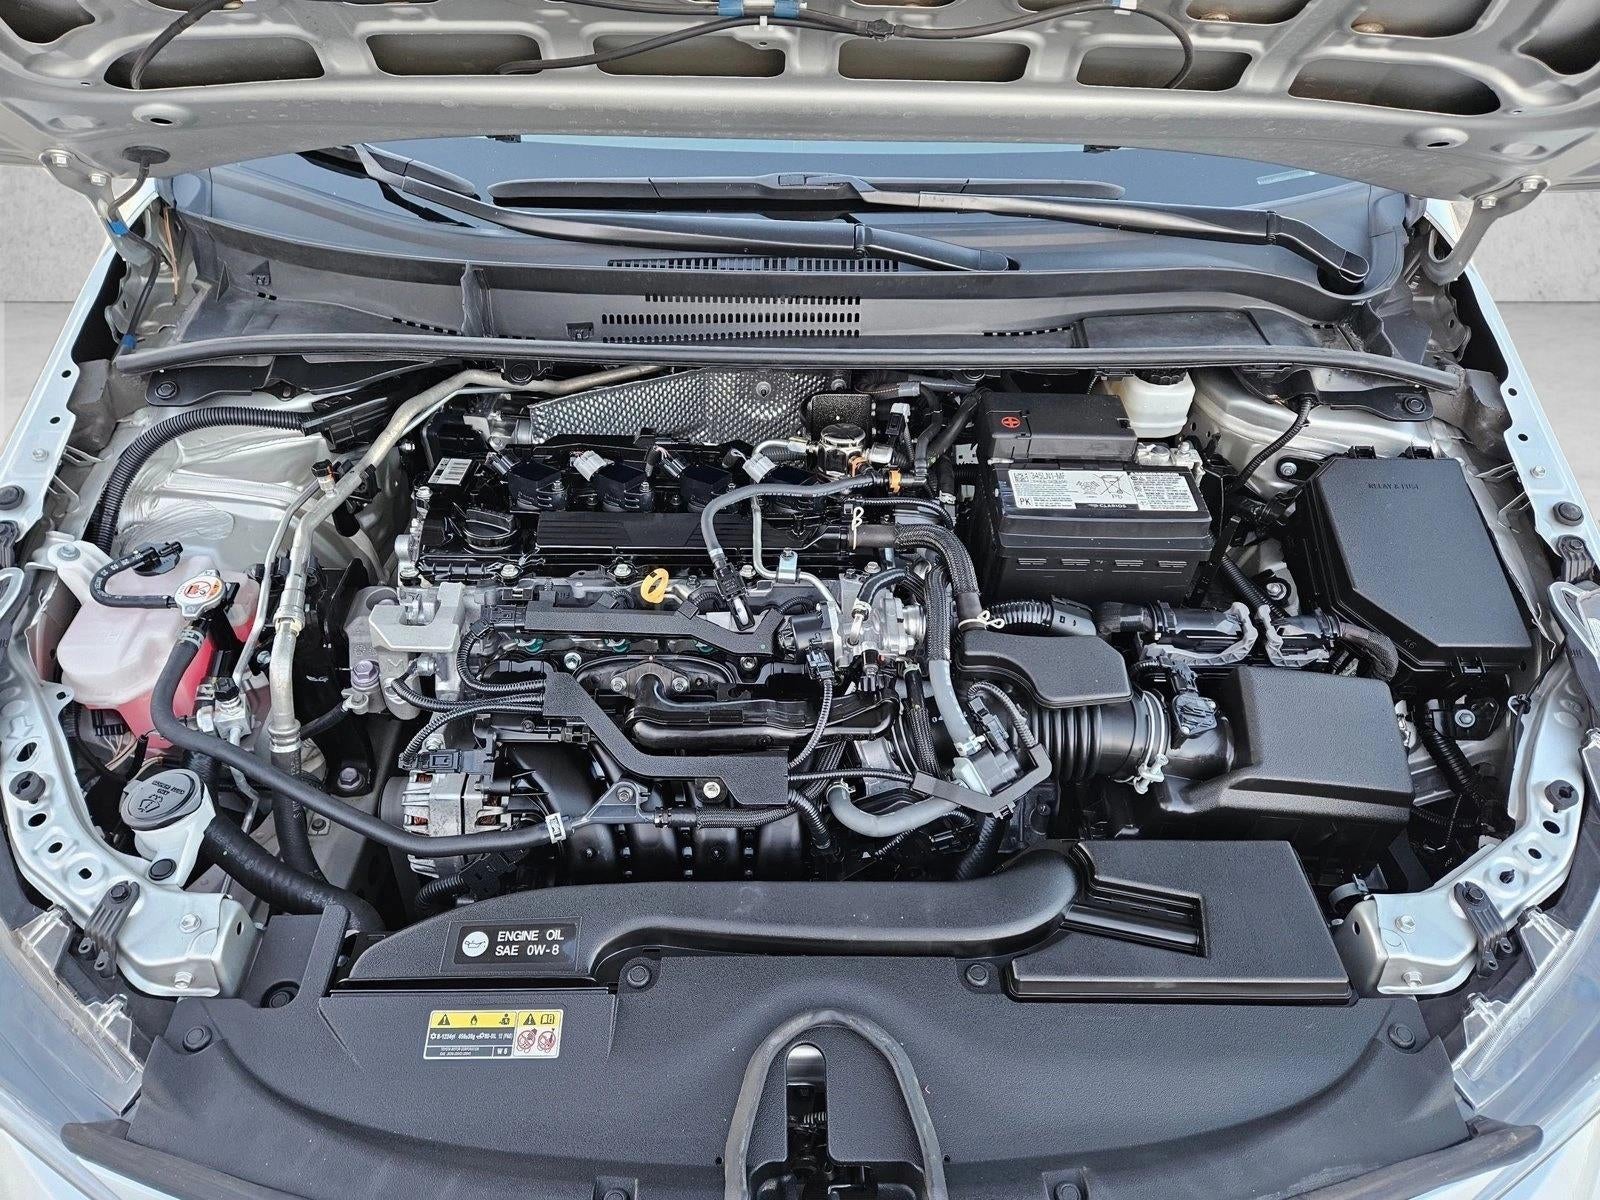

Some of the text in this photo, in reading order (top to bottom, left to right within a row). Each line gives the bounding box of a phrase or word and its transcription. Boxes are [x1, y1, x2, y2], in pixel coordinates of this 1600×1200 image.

[1020, 497, 1032, 506] PK
[497, 929, 565, 942] ENGINE OIL
[495, 944, 560, 956] SAE 0W-8
